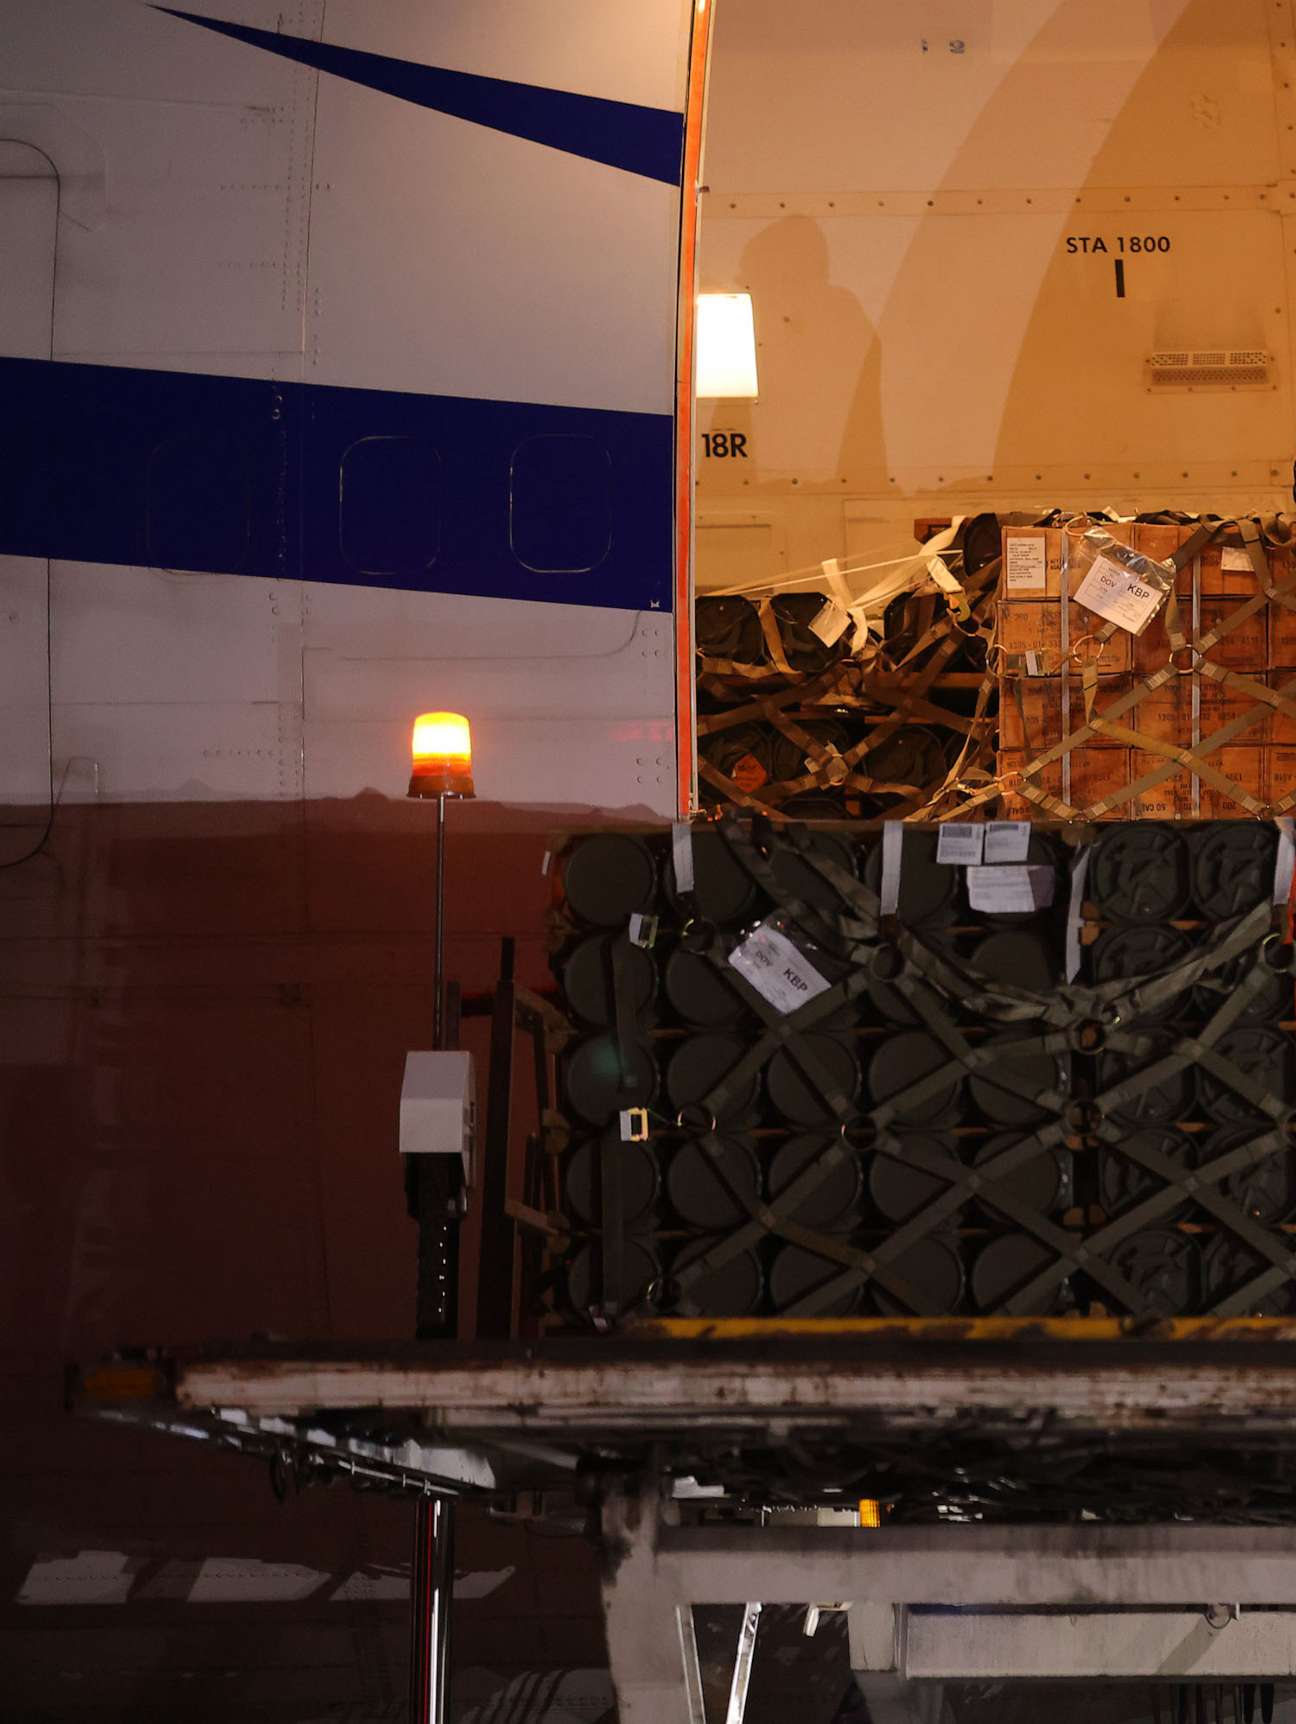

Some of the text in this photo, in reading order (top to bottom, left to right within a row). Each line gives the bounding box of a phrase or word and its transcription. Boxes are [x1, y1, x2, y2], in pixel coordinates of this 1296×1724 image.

[1066, 236, 1171, 254] STA 1800
[701, 433, 749, 458] 18R
[1100, 575, 1117, 588] DOV
[1127, 583, 1150, 599] KBP
[783, 968, 808, 991] KBP
